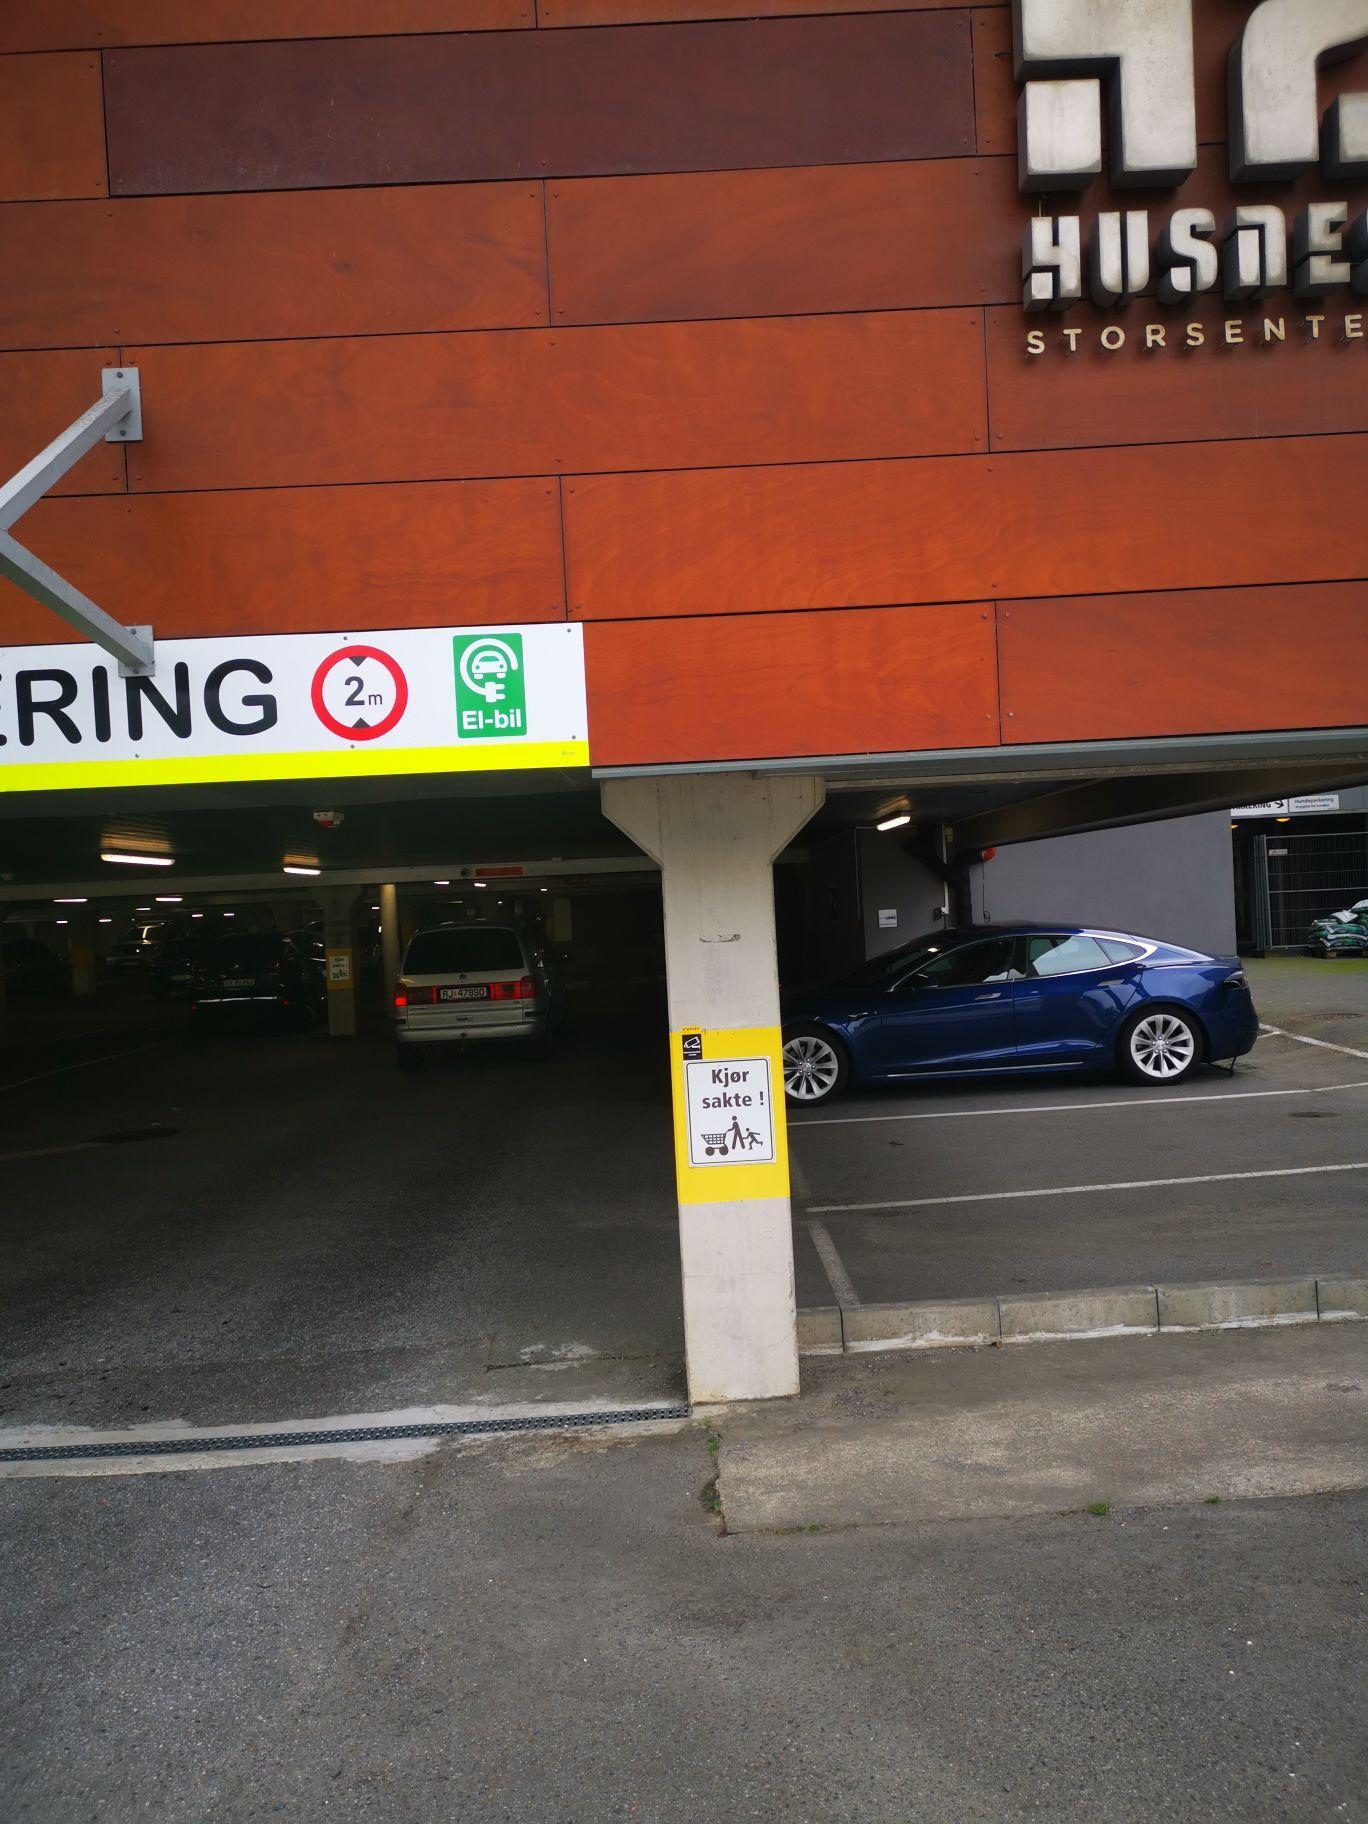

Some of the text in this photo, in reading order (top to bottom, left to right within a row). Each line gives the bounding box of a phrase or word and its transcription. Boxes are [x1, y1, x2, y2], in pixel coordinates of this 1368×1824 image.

[1029, 202, 1368, 300] HUSNE
[1027, 314, 1363, 354] STORSENTE
[0, 658, 278, 746] RING
[462, 708, 522, 730] El-bil
[711, 1068, 750, 1088] Kjør
[702, 1091, 764, 1109] sakte !
